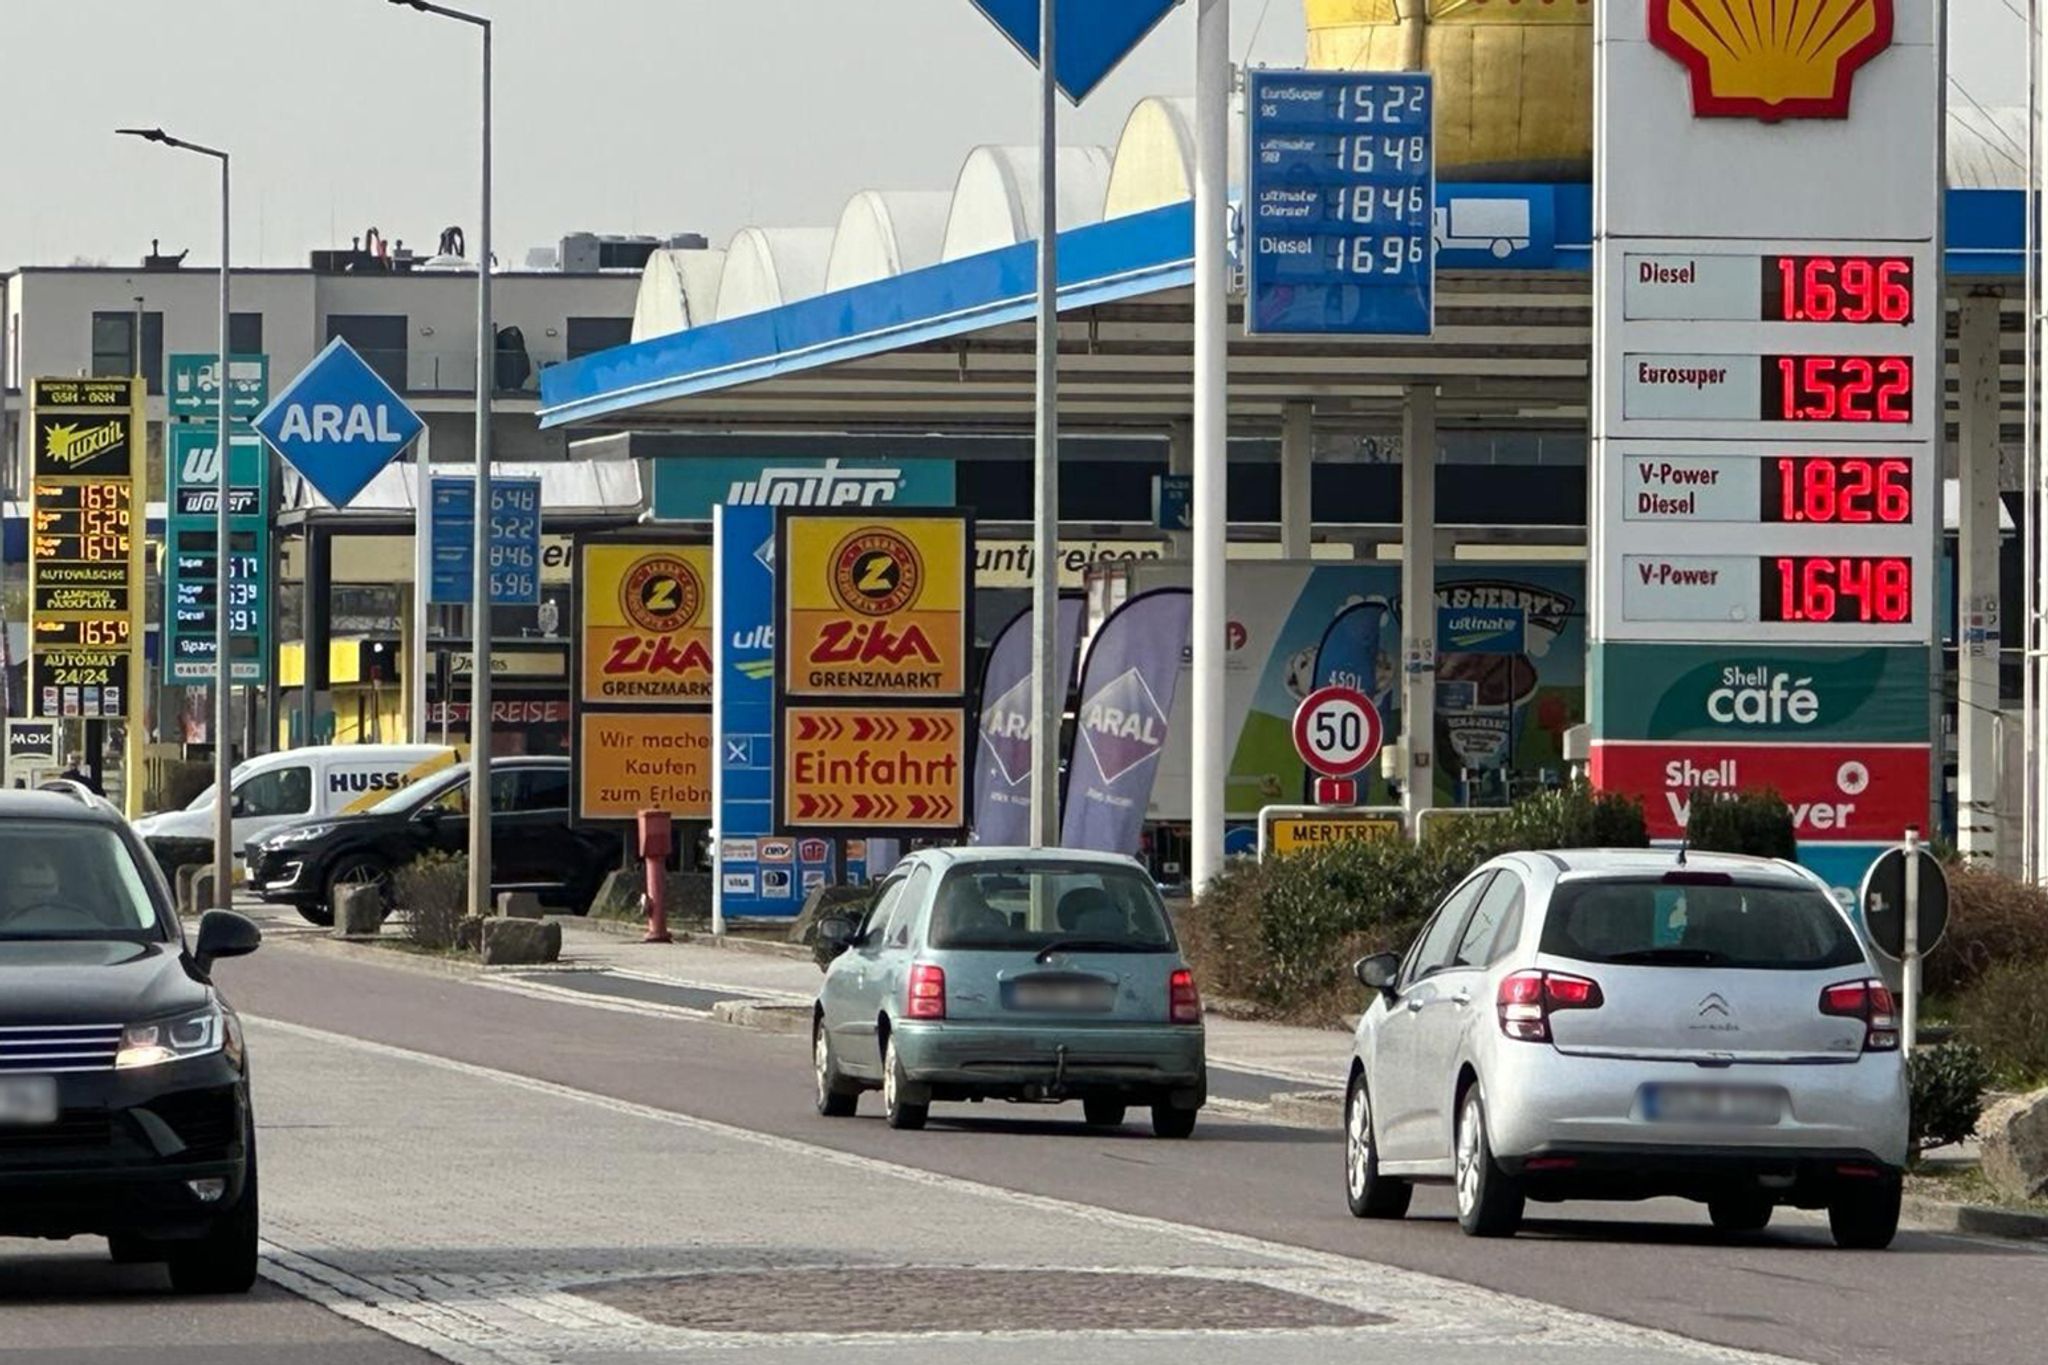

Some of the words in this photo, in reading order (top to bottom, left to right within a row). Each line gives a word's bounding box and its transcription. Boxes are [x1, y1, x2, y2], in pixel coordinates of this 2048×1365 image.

[1337, 85, 1425, 123] 1522
[1336, 135, 1424, 173] 1648
[1336, 186, 1423, 223] 1846
[1259, 236, 1312, 254] Diesel
[1336, 236, 1423, 274] 1696
[1639, 260, 1696, 284] Diesel
[1779, 258, 1910, 321] 1.696
[1638, 362, 1727, 390] Eurosuper
[1779, 358, 1910, 420] 1.522
[278, 403, 403, 443] ARAL
[1638, 462, 1720, 486] V-Power
[1778, 459, 1910, 522] 1.826
[1638, 491, 1695, 515] Diesel
[1638, 562, 1719, 586] V-Power
[1777, 558, 1909, 621] 1.648
[809, 671, 942, 688] GRENZMARKT
[1723, 666, 1767, 687] Shell
[1707, 672, 1819, 724] café
[600, 730, 633, 748] Wir
[642, 731, 713, 749] mache
[1086, 703, 1159, 746] ARAL
[1315, 711, 1362, 751] 50
[625, 758, 697, 775] Kaufen
[794, 750, 957, 785] Einfahrt
[1665, 759, 1737, 787] Shell
[600, 788, 641, 801] zum
